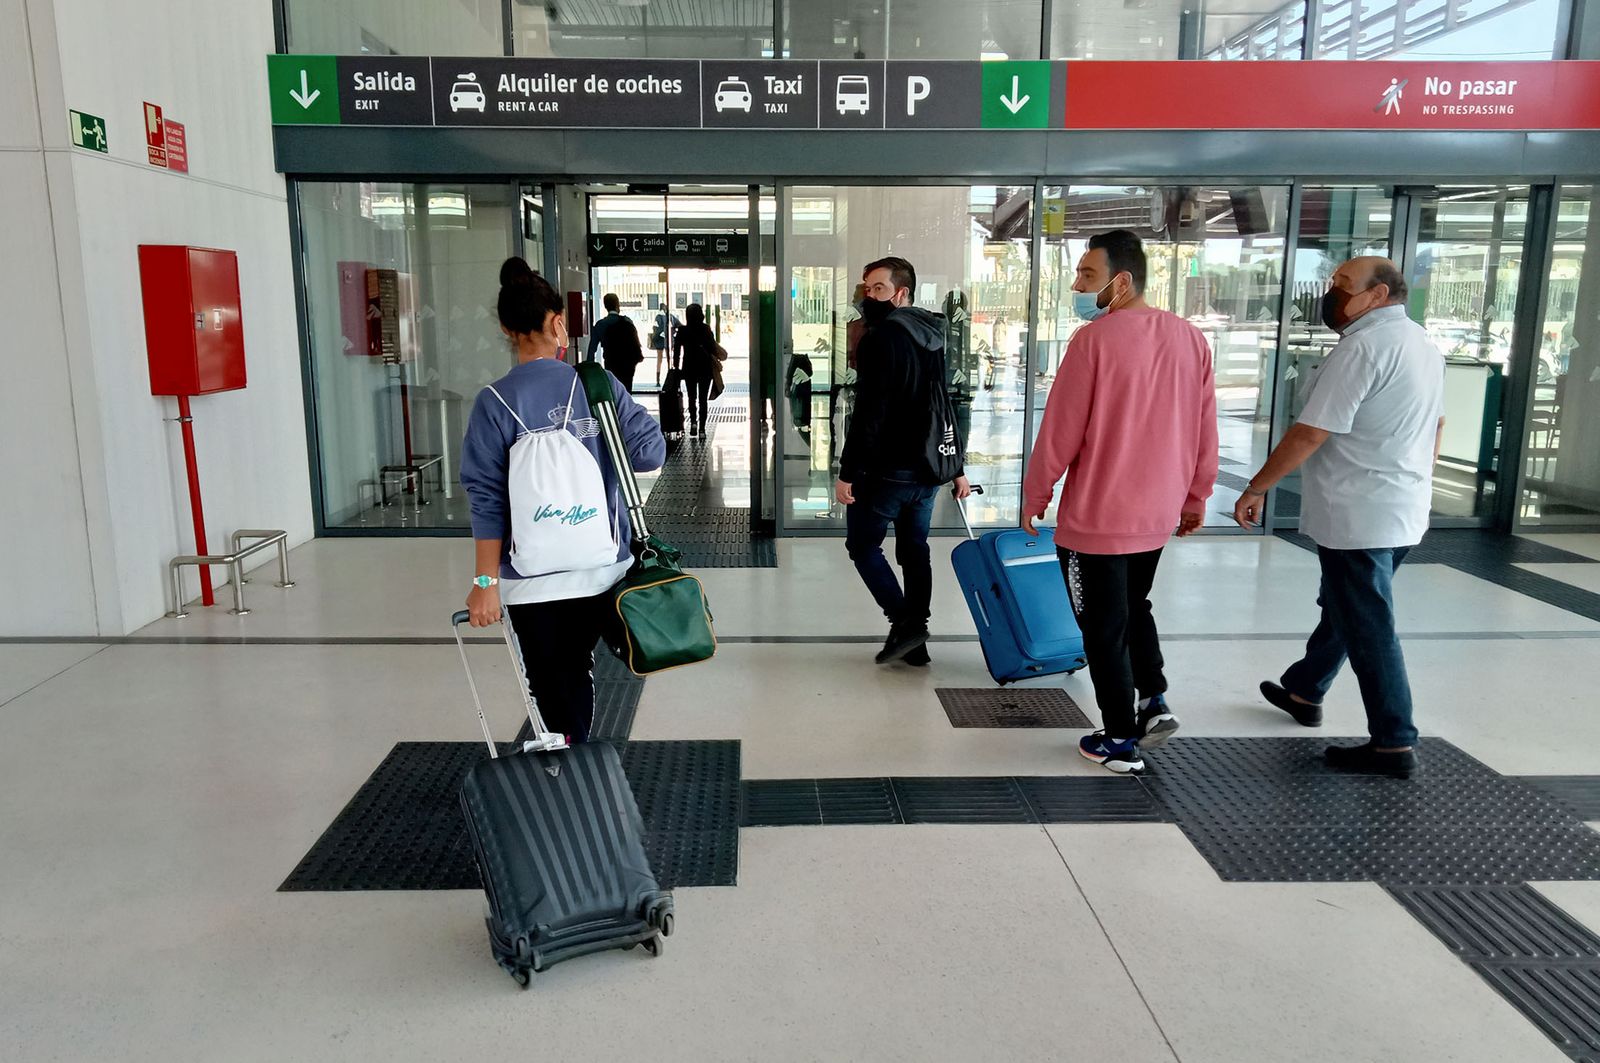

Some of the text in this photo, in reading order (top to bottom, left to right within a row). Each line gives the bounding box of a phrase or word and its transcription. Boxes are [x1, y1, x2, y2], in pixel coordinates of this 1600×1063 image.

[353, 71, 416, 91] Salida
[497, 73, 683, 97] Alquiler de coches
[764, 74, 803, 95] Taxi
[1424, 77, 1518, 100] No pasar
[355, 100, 380, 110] EXIT
[907, 76, 931, 116] P
[497, 101, 559, 112] RENT A CAR
[763, 103, 788, 114] TAXI
[1422, 104, 1514, 115] NO TRESPASSING
[643, 238, 665, 246] Salida
[534, 504, 564, 522] Vive
